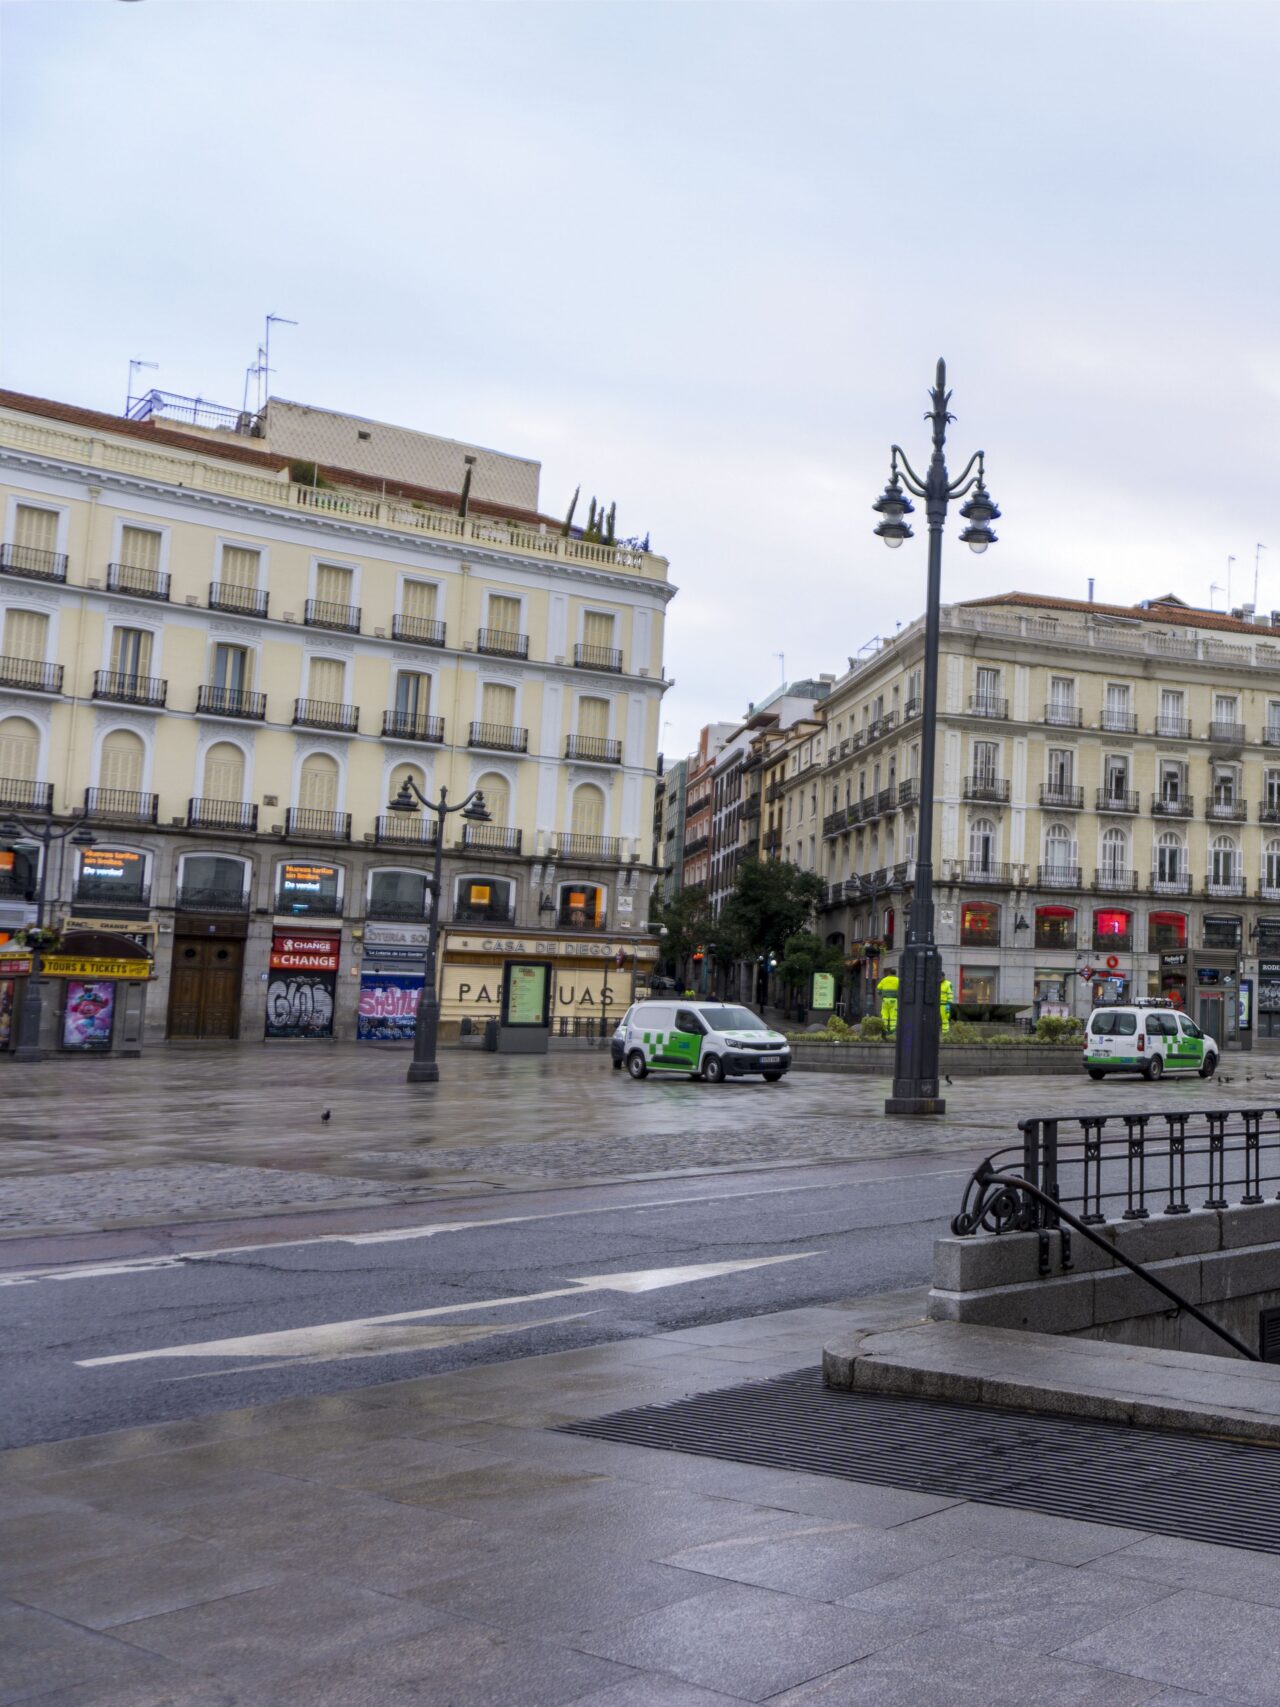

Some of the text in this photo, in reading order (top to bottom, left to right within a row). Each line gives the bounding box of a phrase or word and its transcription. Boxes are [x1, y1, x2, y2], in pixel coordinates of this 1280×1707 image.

[294, 941, 331, 951] CHANGE
[481, 938, 613, 956] CASA DE DIEGO
[281, 954, 336, 967] CHANGE
[48, 961, 77, 972] TOURS
[79, 962, 88, 972] &
[90, 962, 127, 974] TICKETS
